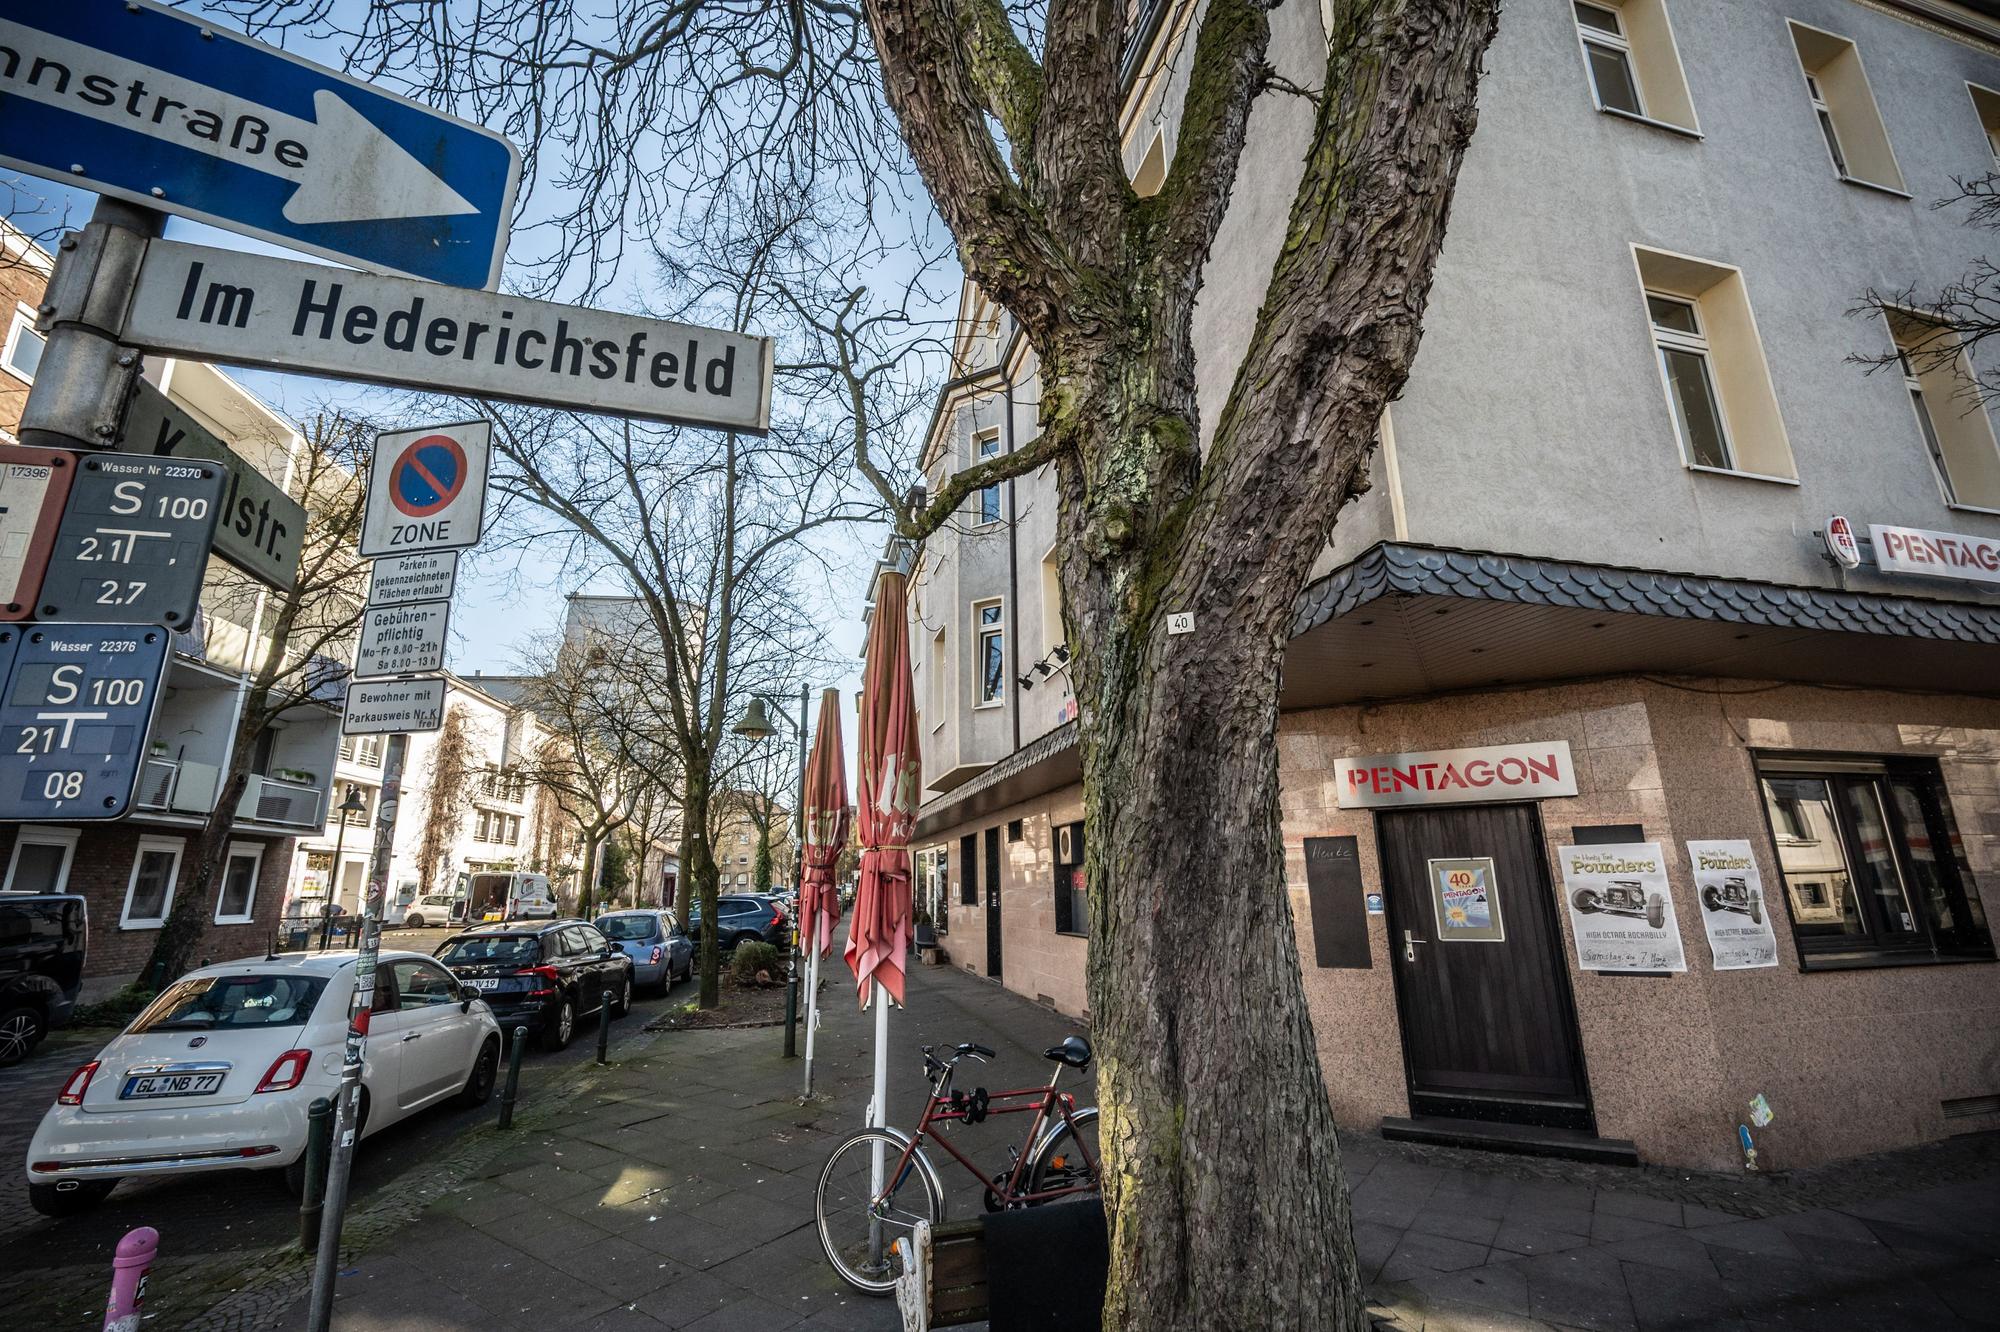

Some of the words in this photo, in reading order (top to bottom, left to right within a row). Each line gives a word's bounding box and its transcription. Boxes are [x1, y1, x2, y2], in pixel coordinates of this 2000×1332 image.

[175, 262, 255, 328] Im
[292, 279, 736, 398] Hederichsfeld
[11, 467, 48, 478] 17396
[101, 462, 144, 475] Wasser
[148, 465, 162, 475] Nr
[165, 466, 202, 478] 22370
[109, 481, 146, 514] S
[158, 496, 208, 520] 100
[389, 520, 451, 545] ZONE
[1882, 532, 2000, 572] PENTAG
[399, 560, 427, 571] Parken
[429, 558, 438, 568] in
[375, 571, 450, 589] gekennzeichneten
[96, 580, 147, 605] 2,7
[379, 587, 411, 600] Flächen
[413, 583, 443, 594] erlaubt
[1174, 617, 1188, 629] 40
[376, 626, 424, 645] pflichtig
[50, 641, 93, 652] Wasser
[99, 641, 137, 652] 22376
[377, 660, 389, 670] Sa
[46, 665, 84, 705] S
[92, 679, 144, 705] 100
[360, 692, 410, 703] Bewohner
[414, 690, 431, 701] mit
[348, 711, 411, 723] Parkausweis
[418, 718, 436, 728] frei
[1347, 753, 1560, 794] PENTAGON
[1570, 858, 1657, 875] Pounders
[1698, 854, 1752, 870] Pounders
[1450, 872, 1470, 886] 40
[1443, 886, 1485, 899] PENTAGON
[1627, 931, 1667, 939] ROCKABILLY
[486, 979, 496, 988] 19
[136, 1078, 157, 1093] GL
[167, 1076, 192, 1092] NB
[194, 1075, 217, 1090] 77
